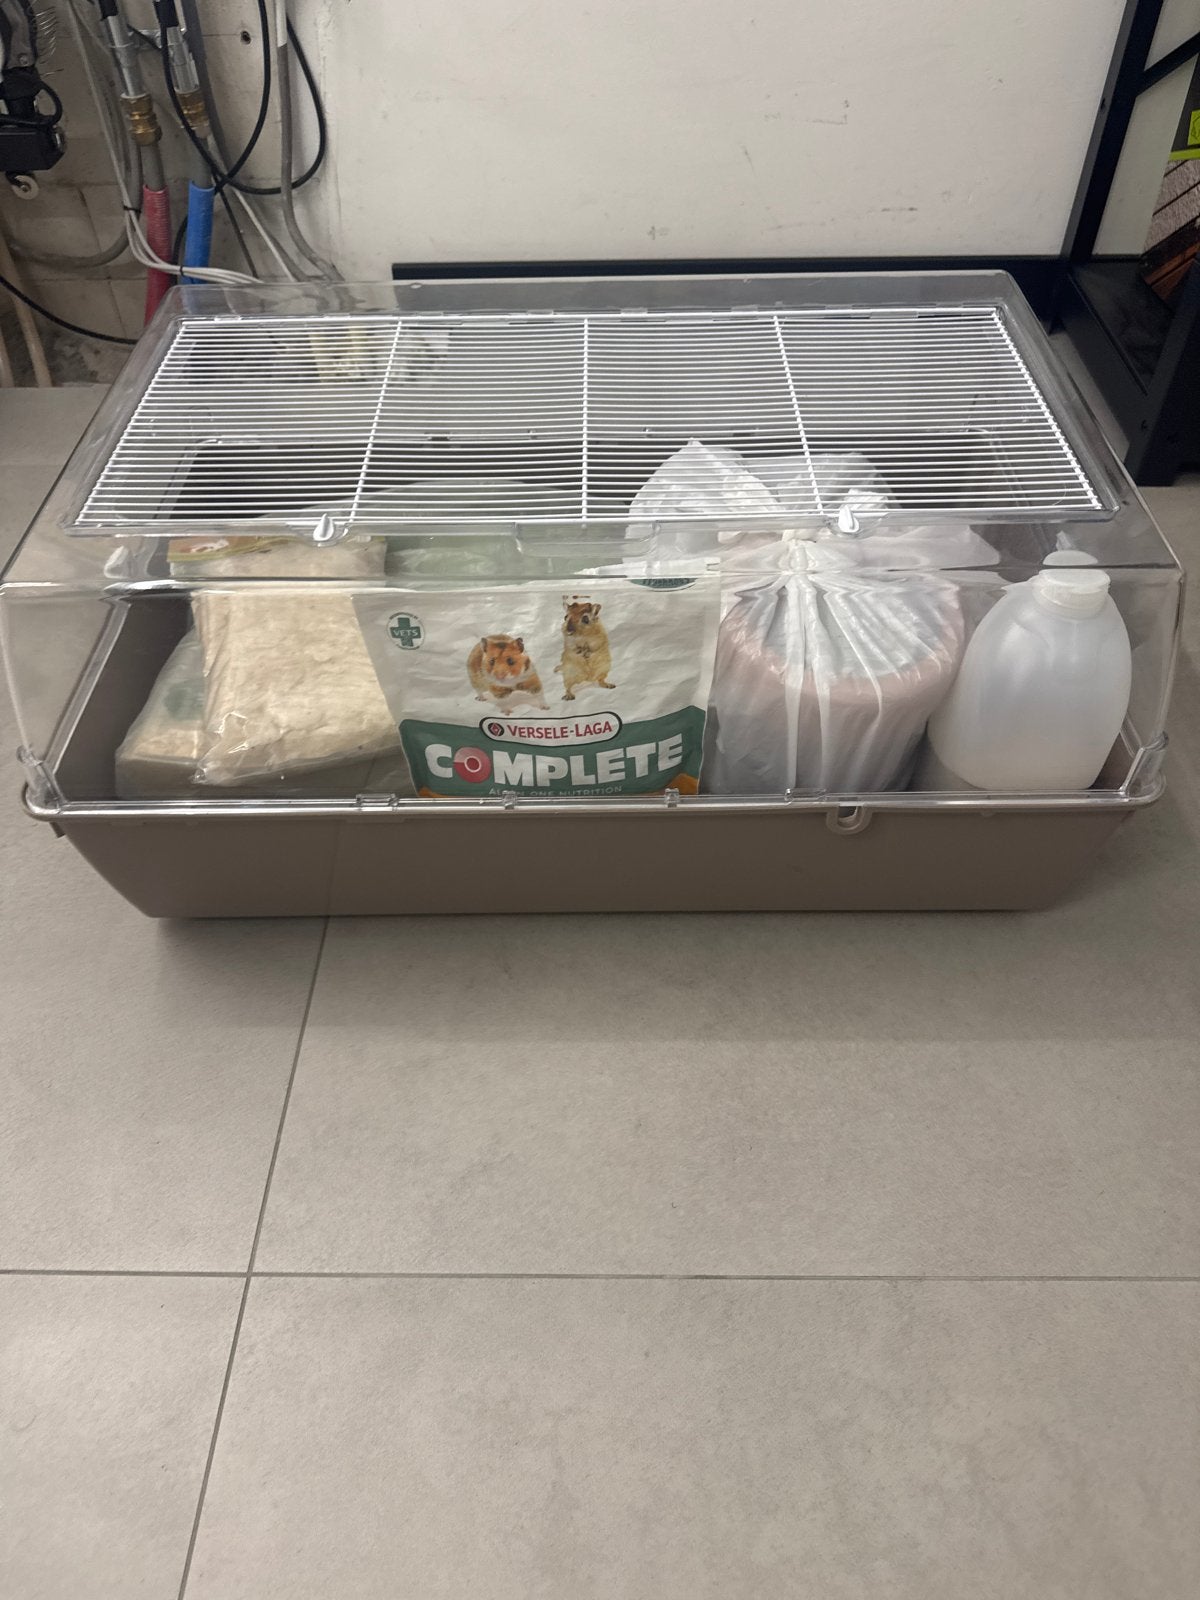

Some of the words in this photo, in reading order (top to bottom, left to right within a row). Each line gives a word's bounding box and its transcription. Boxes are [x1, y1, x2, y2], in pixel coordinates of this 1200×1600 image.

[393, 629, 419, 637] VETS
[507, 721, 613, 739] VERSELE-LAGA
[425, 733, 683, 787] COMPLETE
[559, 785, 622, 797] NUTRITION
